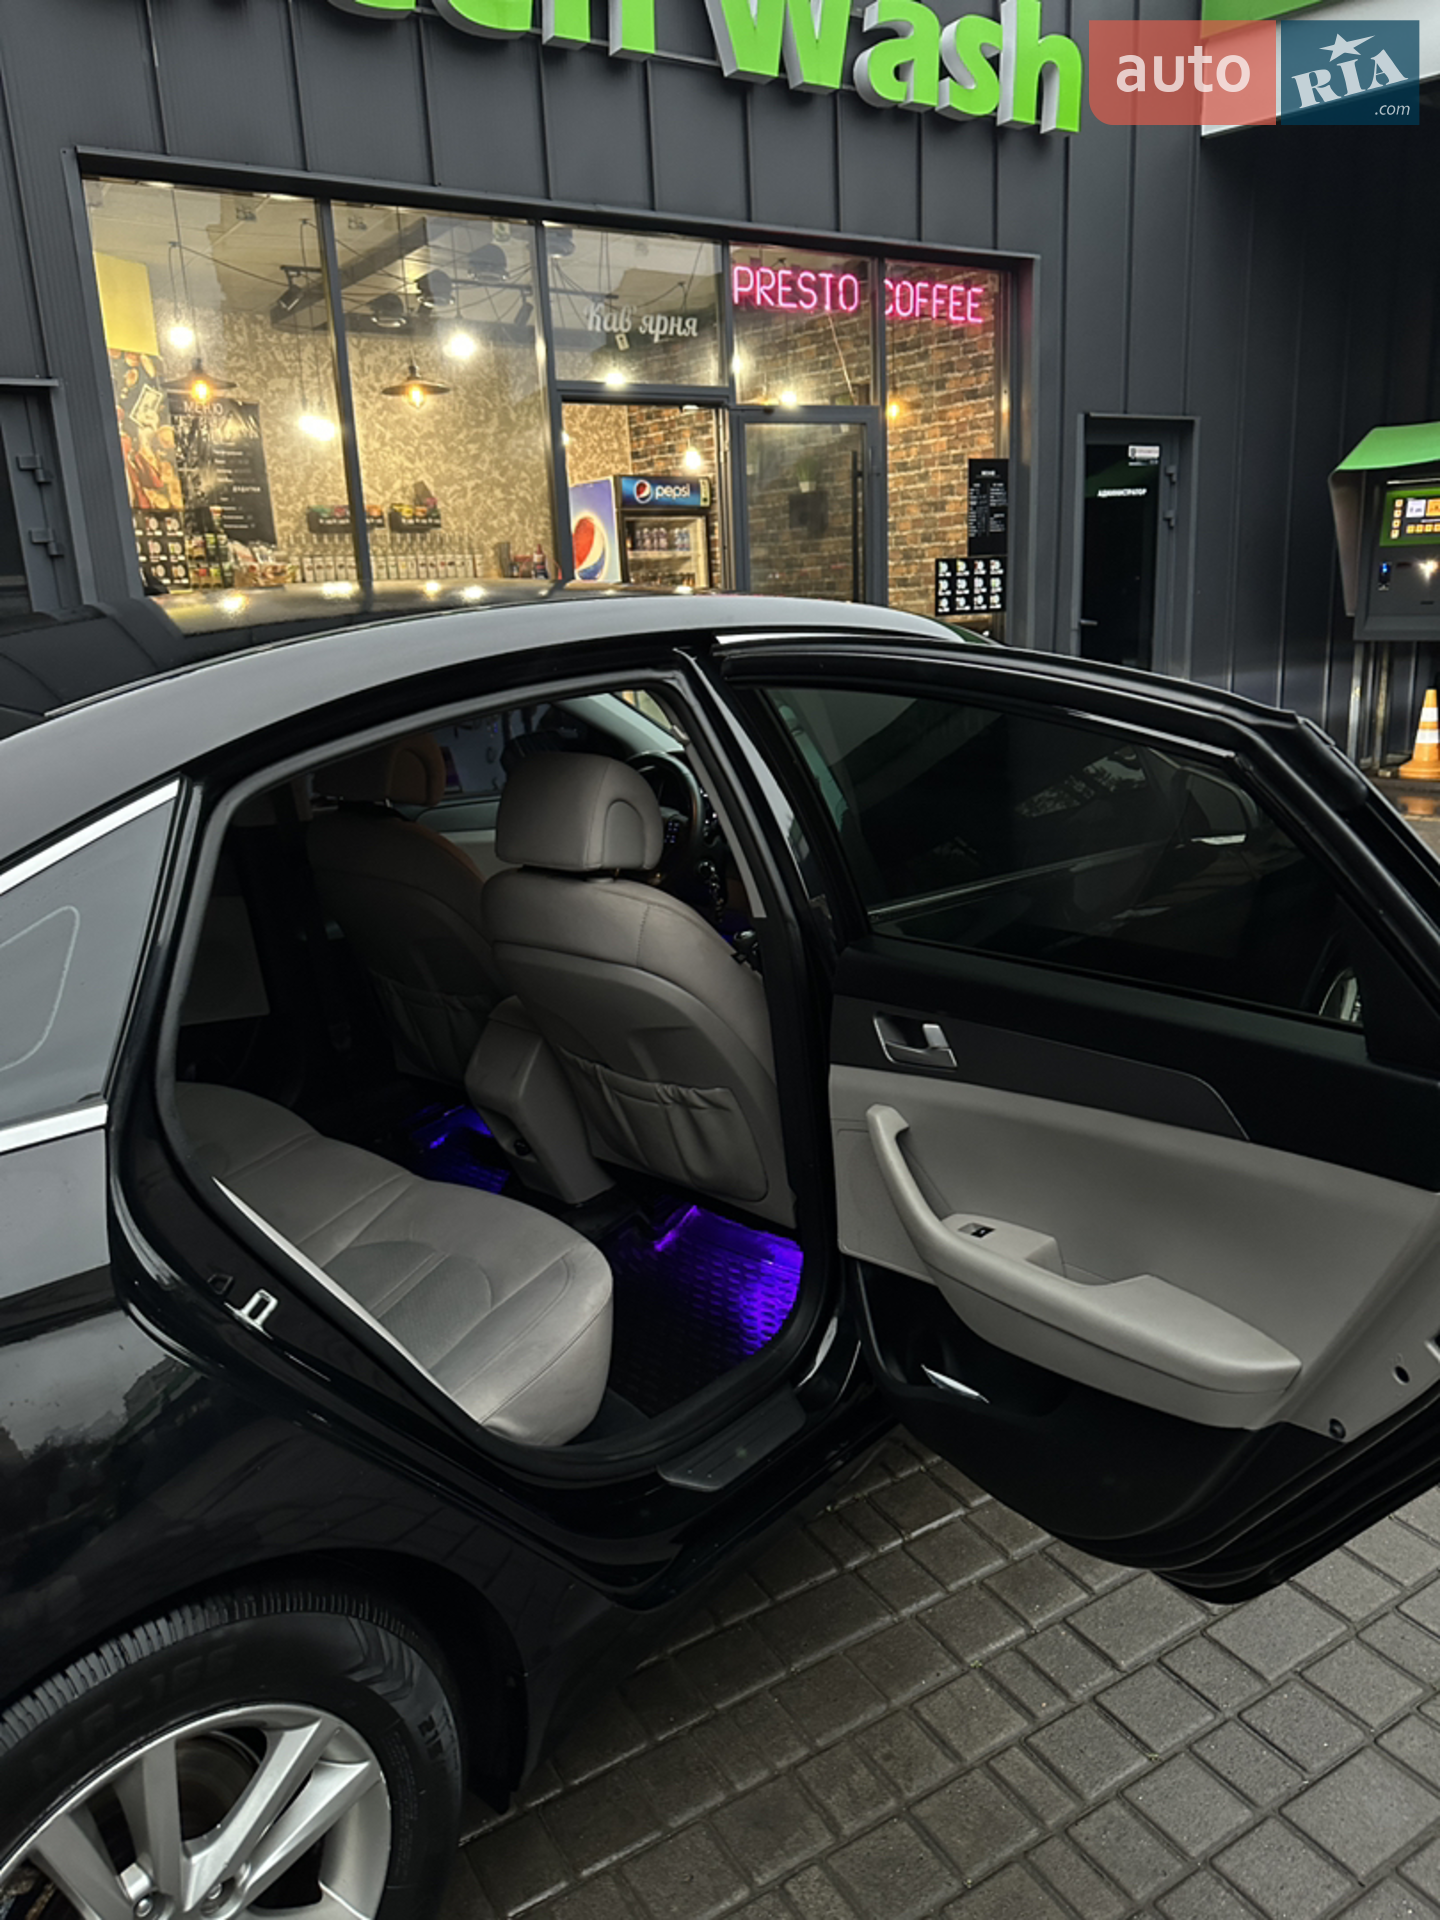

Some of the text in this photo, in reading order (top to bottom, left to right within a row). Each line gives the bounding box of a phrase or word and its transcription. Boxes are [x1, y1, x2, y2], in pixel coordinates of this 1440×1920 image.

[702, 0, 1082, 134] Wash
[733, 265, 860, 312] PRESTO
[655, 483, 691, 500] pepsi
